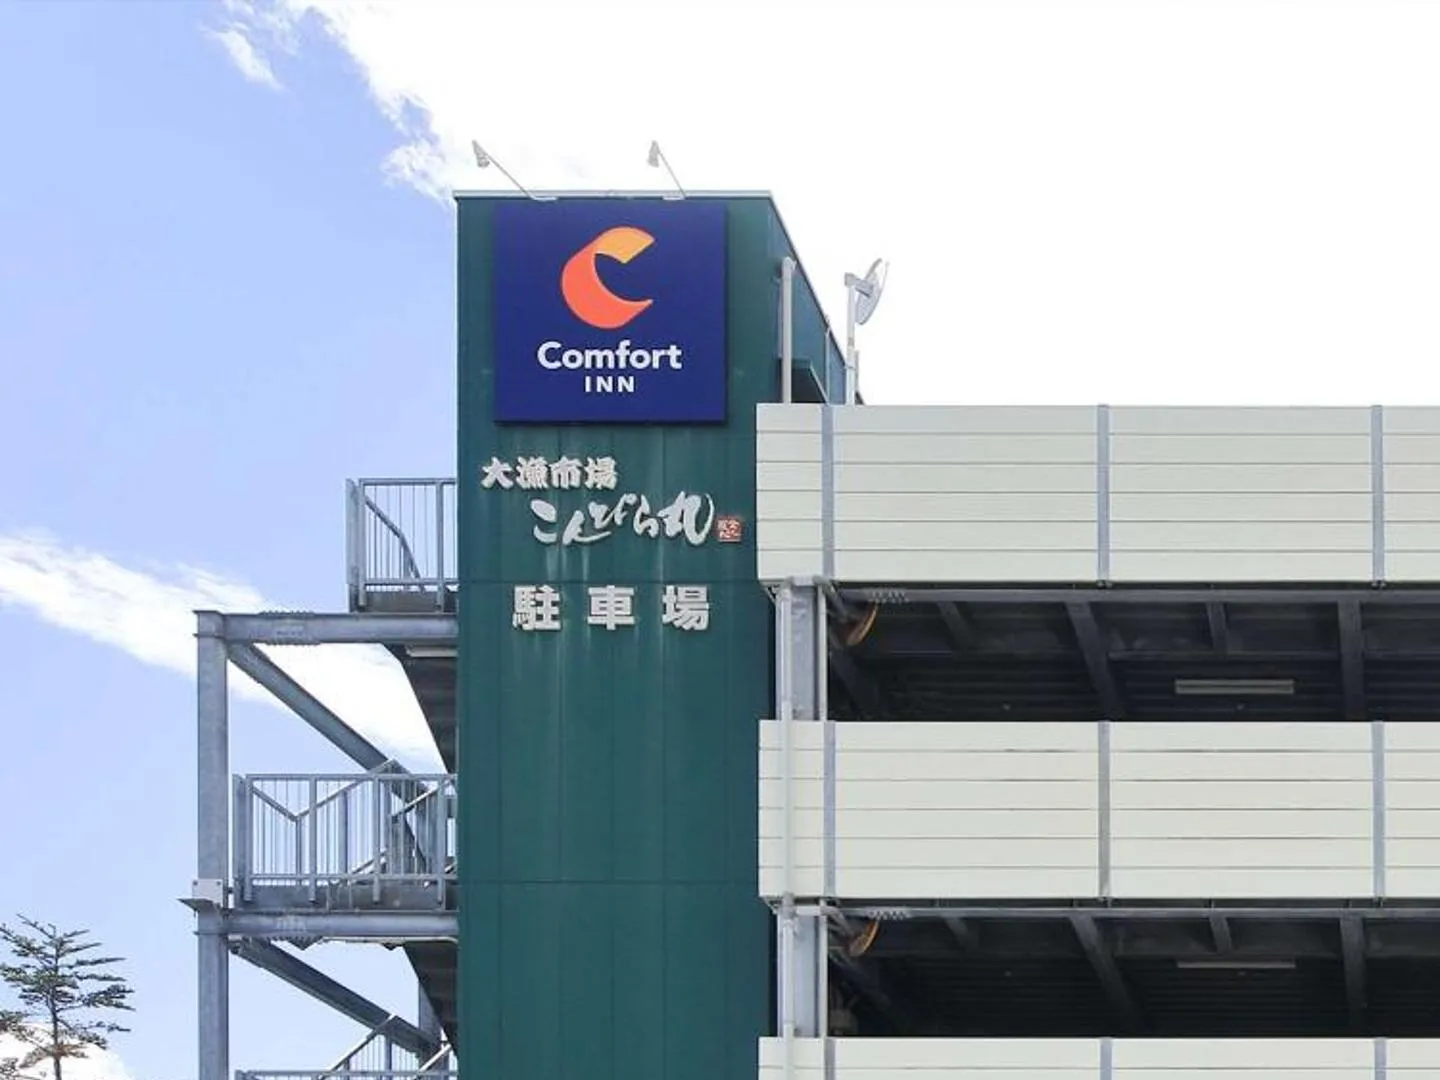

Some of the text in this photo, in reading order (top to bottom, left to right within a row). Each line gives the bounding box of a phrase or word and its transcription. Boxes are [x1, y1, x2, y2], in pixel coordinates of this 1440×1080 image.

[538, 339, 682, 369] Comfort
[585, 376, 634, 392] INN
[481, 456, 617, 489] 大漁市場
[513, 585, 709, 631] 駐車場
